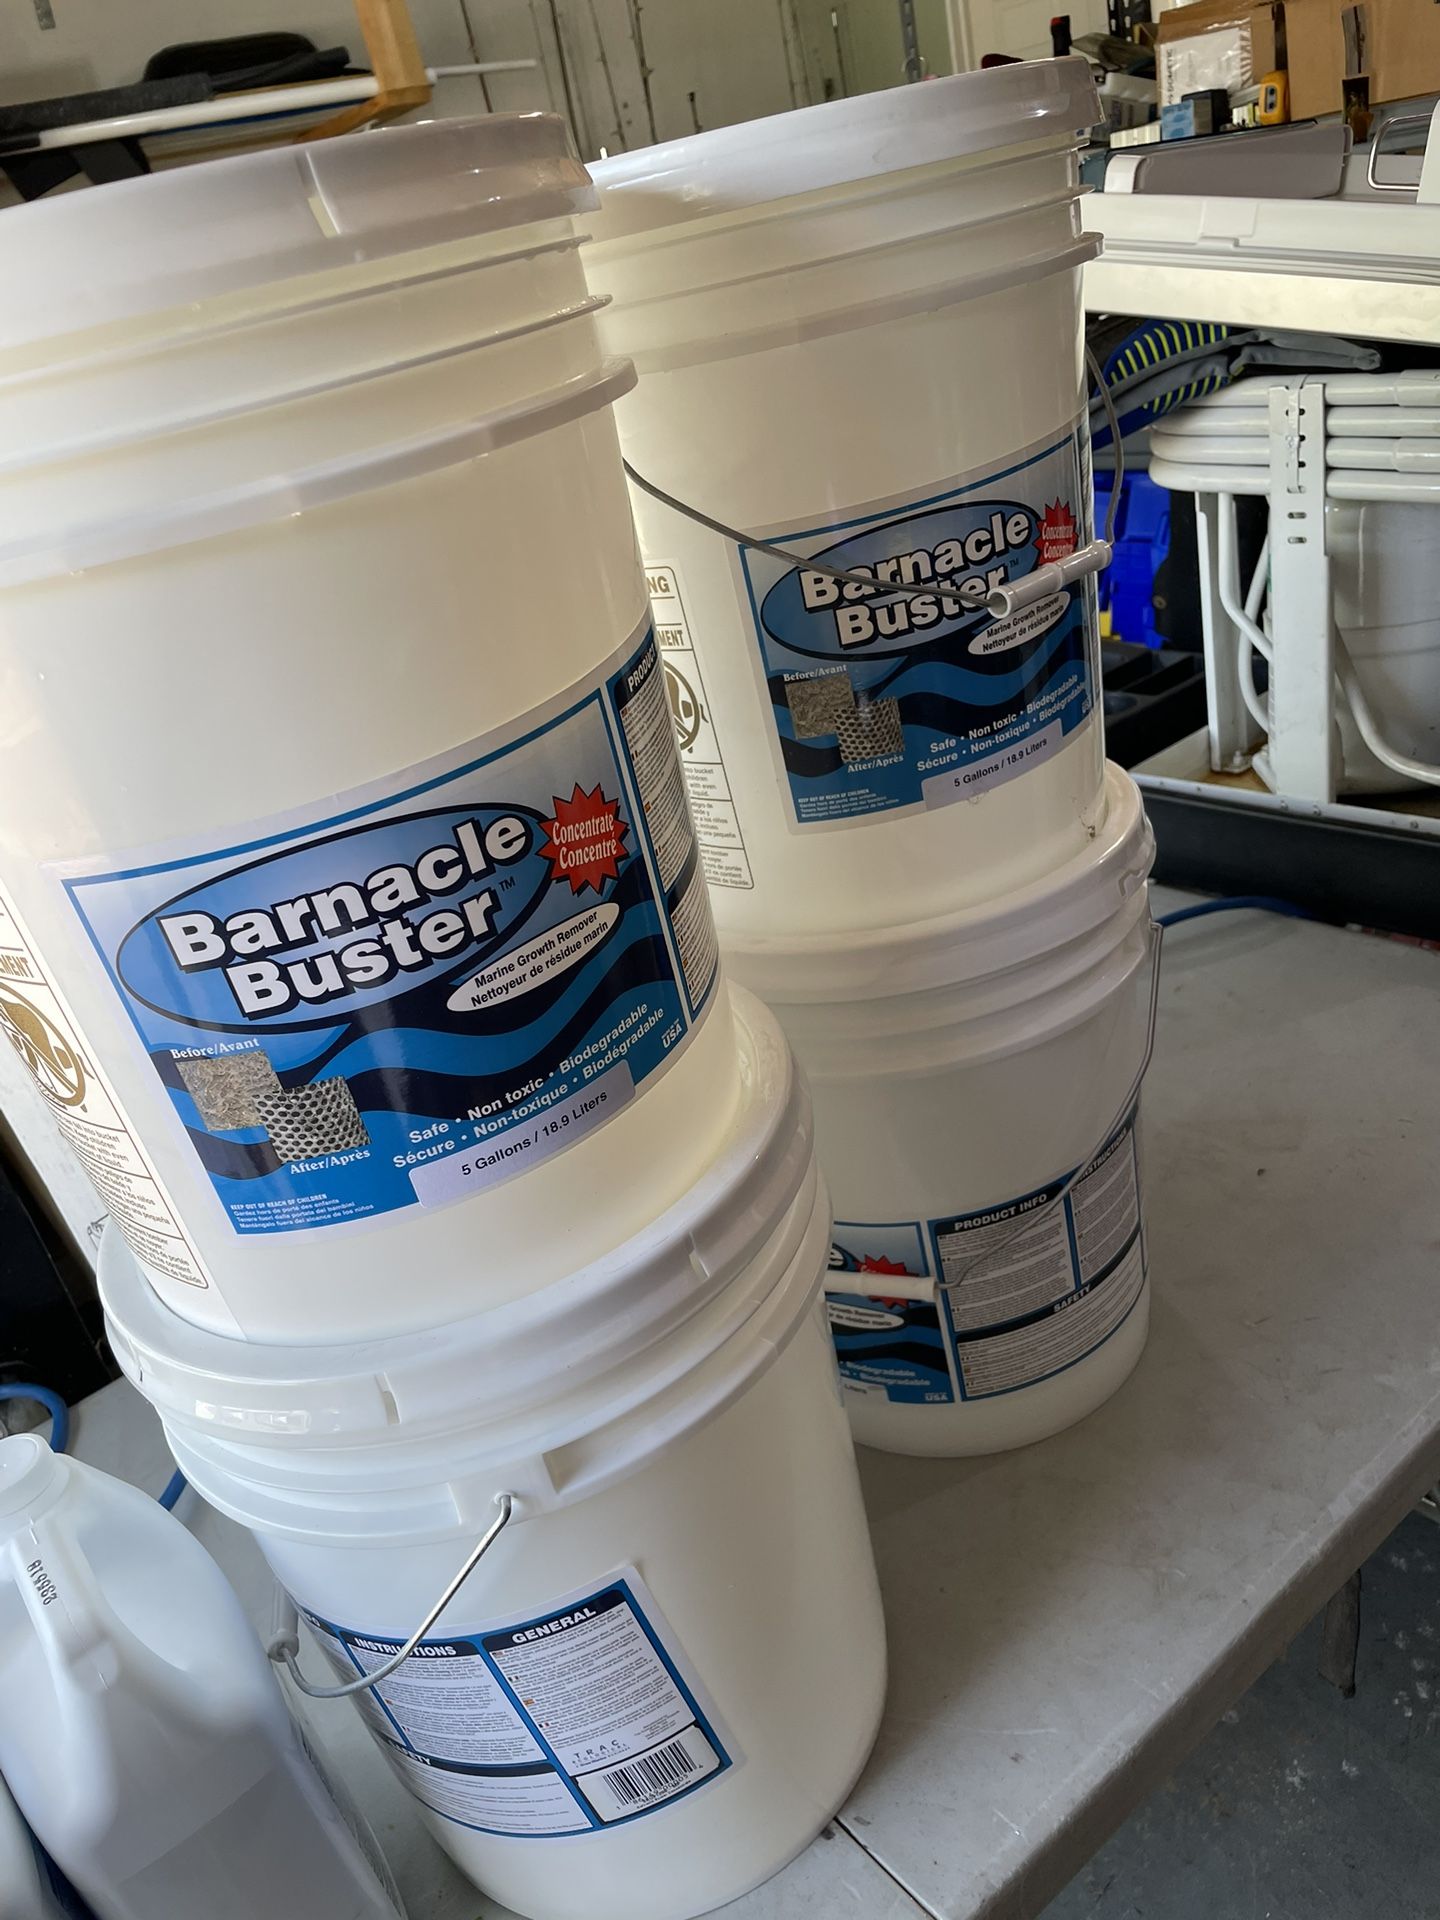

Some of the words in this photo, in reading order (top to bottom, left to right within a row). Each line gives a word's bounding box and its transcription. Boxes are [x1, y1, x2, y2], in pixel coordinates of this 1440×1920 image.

[799, 511, 1031, 612] Barnacle
[835, 563, 1007, 648] Buster
[986, 621, 1012, 640] Marine
[1012, 608, 1036, 631] Growth
[981, 632, 1018, 654] Nettoyeur
[1018, 628, 1028, 638] de
[782, 663, 848, 683] Before/Avant
[929, 736, 957, 754] Safe
[967, 725, 991, 741] Non
[991, 712, 1018, 734] toxic
[1025, 673, 1078, 713] Biodegradable
[847, 752, 905, 775] After/Après
[916, 750, 959, 773] Sécure
[970, 719, 1031, 755] Non-toxique
[953, 777, 961, 788] 5
[962, 761, 1000, 785] Gallons
[1006, 748, 1025, 766] 18.9
[1025, 737, 1048, 757] Liters
[551, 811, 615, 846] Concentrate
[558, 832, 618, 870] Concentré
[158, 816, 530, 971] Barnacle
[223, 890, 496, 1018] Buster
[498, 875, 517, 893] TM
[470, 973, 528, 1008] Nettoyeur
[528, 962, 545, 977] de
[545, 941, 583, 968] résidue
[582, 919, 609, 946] marin
[473, 960, 516, 990] Marine
[516, 938, 557, 971] Growth
[555, 910, 600, 946] Remover
[169, 1036, 261, 1060] Before/Avant
[661, 1022, 684, 1050] USA
[392, 1138, 456, 1169] Sécure
[472, 1081, 569, 1139] Non-toxique
[581, 1006, 665, 1080] Biodégradable
[408, 1118, 450, 1144] Safe
[466, 1097, 503, 1122] Non
[504, 1076, 545, 1105] toxic
[558, 1001, 650, 1074] Biodegradable
[461, 1163, 472, 1177] 5
[474, 1137, 532, 1171] Gallons
[533, 1130, 540, 1143] /
[541, 1115, 570, 1138] 18.9
[572, 1090, 608, 1120] Liters
[289, 1148, 372, 1176] After/Après
[953, 1206, 1018, 1233] PRODUCT
[1018, 1193, 1049, 1213] INFO
[1053, 1282, 1093, 1315] SAFETY
[511, 1606, 597, 1645] GENERAL
[353, 1635, 458, 1659] INSTRUTIONS
